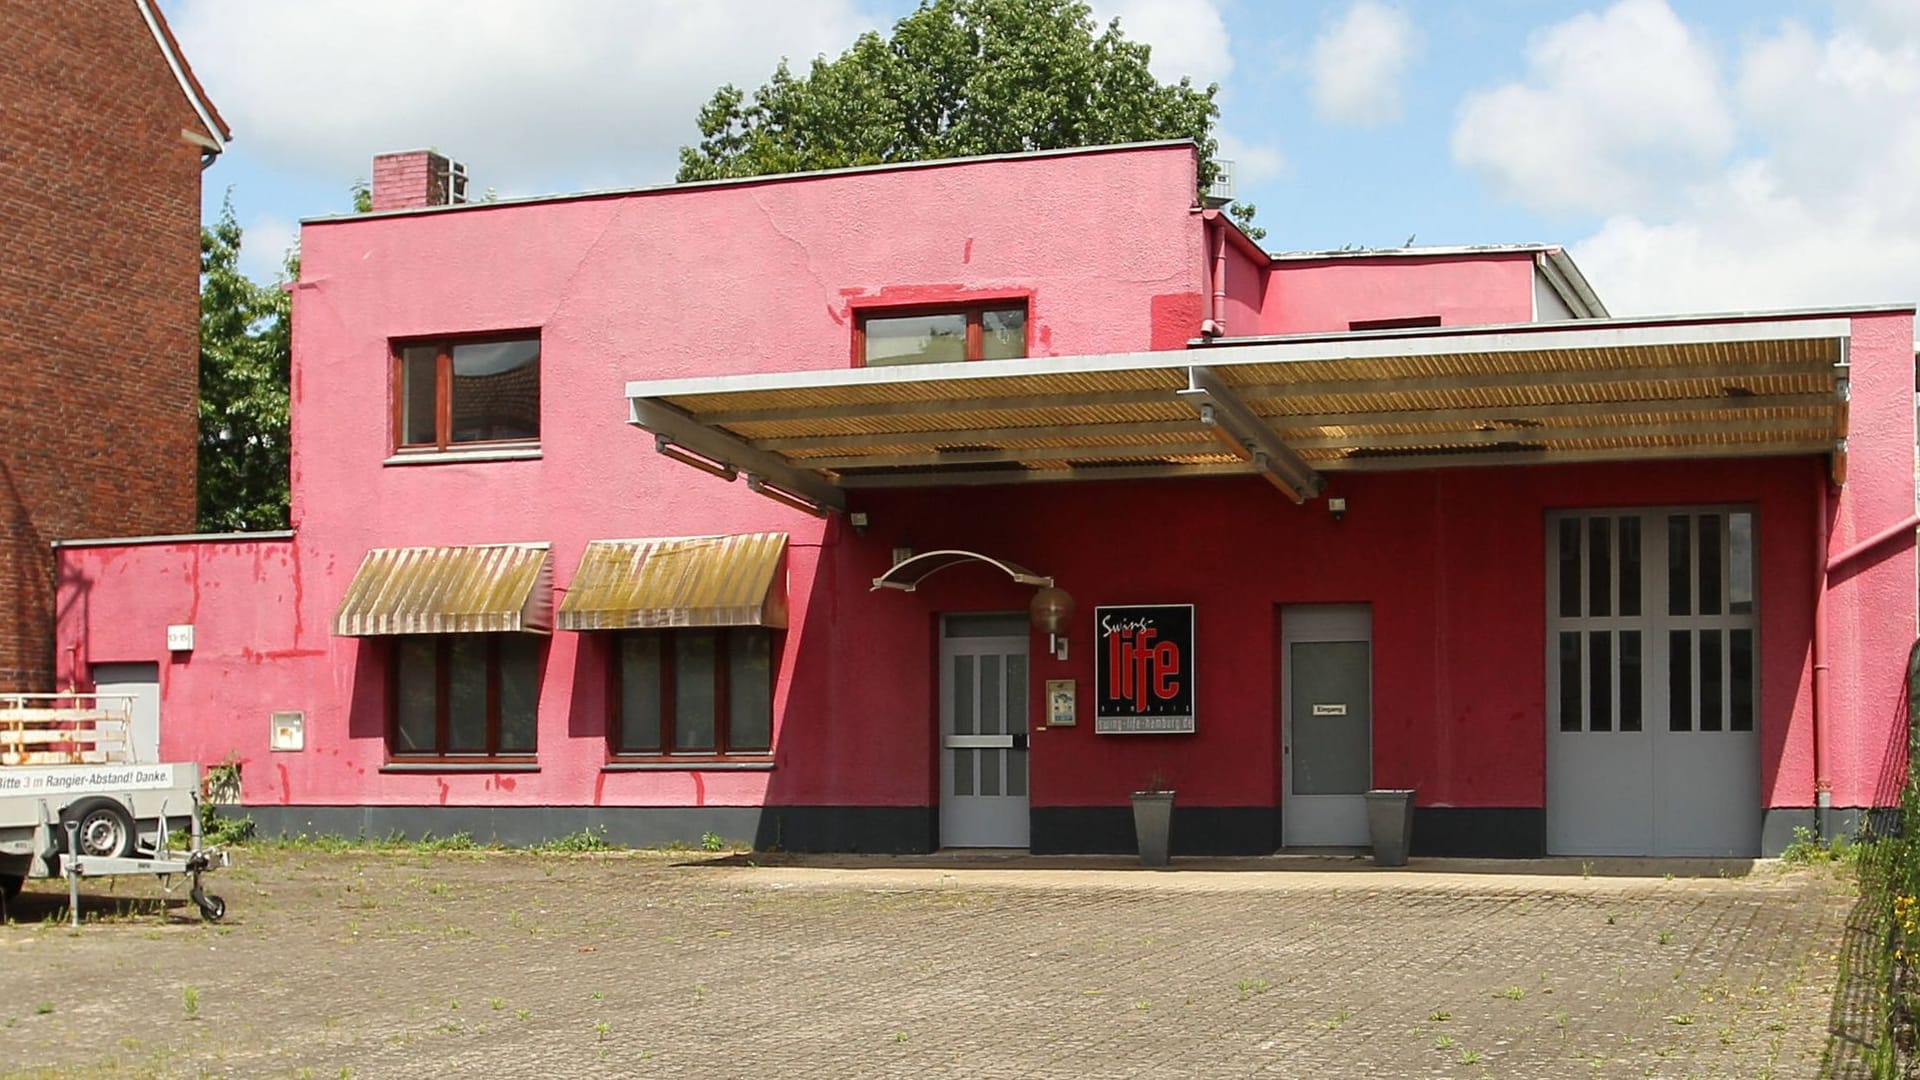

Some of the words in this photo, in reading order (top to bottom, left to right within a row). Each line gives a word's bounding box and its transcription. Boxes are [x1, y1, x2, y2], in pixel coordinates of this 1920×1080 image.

[1110, 628, 1180, 713] life
[23, 776, 31, 788] 3
[32, 777, 43, 788] m
[46, 771, 134, 788] Rangier-Abstand!
[135, 771, 168, 783] Danke.
